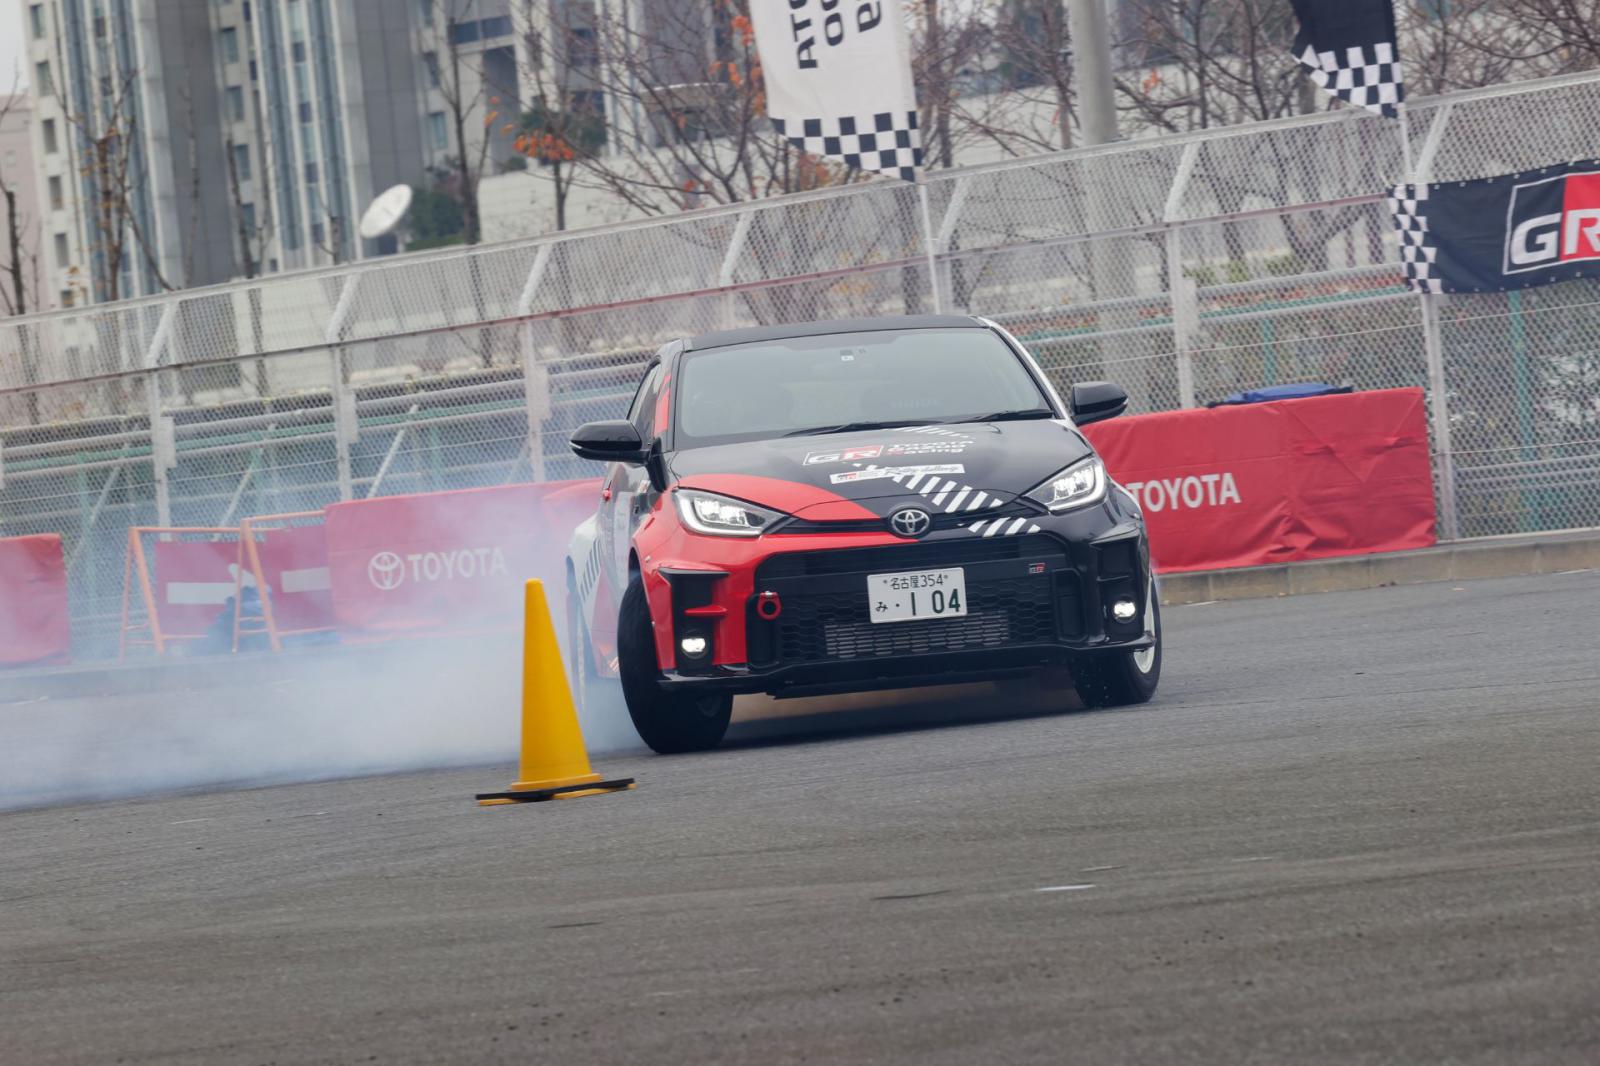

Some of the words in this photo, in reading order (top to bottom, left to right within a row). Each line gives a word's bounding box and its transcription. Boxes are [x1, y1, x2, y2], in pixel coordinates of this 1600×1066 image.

[1510, 208, 1600, 265] GR
[807, 449, 878, 465] GR
[1125, 472, 1242, 512] TOYOTA
[407, 546, 509, 582] TOYOTA
